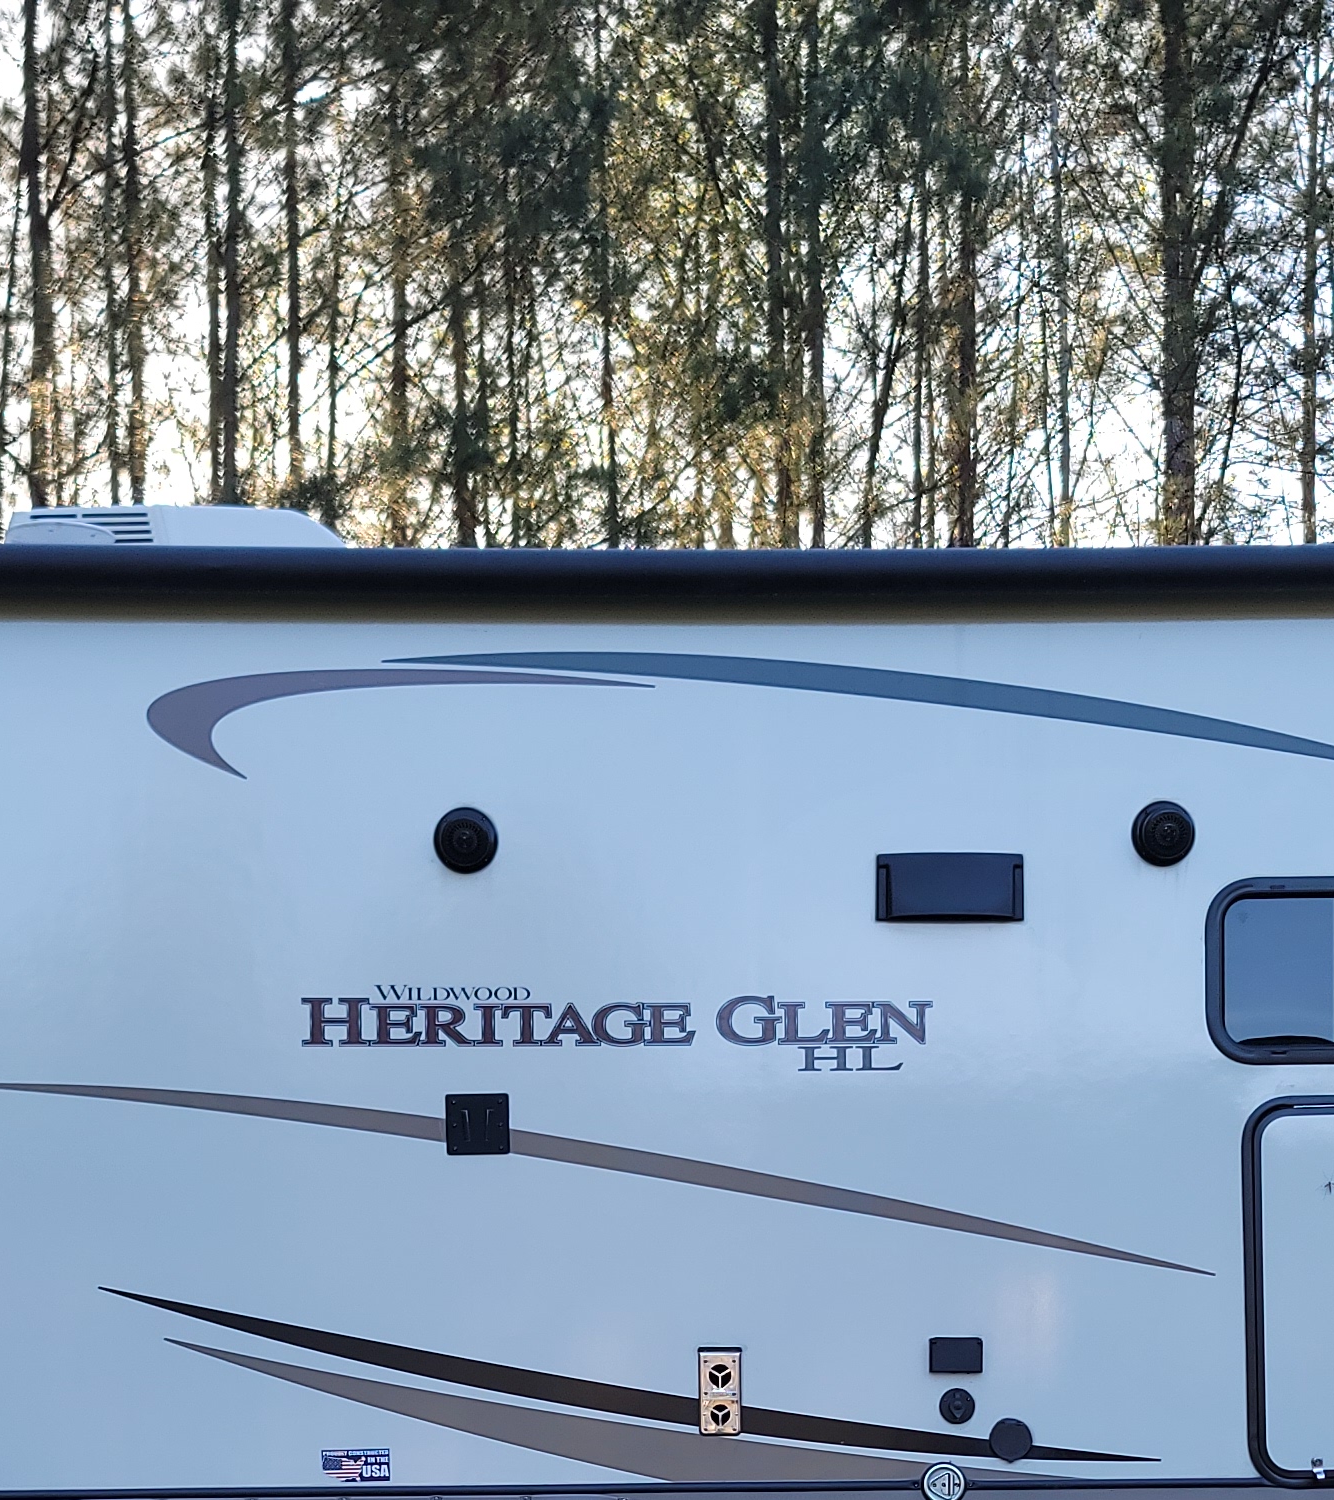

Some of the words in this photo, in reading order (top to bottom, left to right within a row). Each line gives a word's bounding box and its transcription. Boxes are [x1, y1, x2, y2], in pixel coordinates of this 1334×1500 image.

[374, 984, 531, 1001] WILDWOOD
[301, 996, 696, 1048] HERITAGE
[715, 995, 933, 1047] GLEN
[797, 1046, 904, 1072] HL
[362, 1464, 390, 1477] USA
